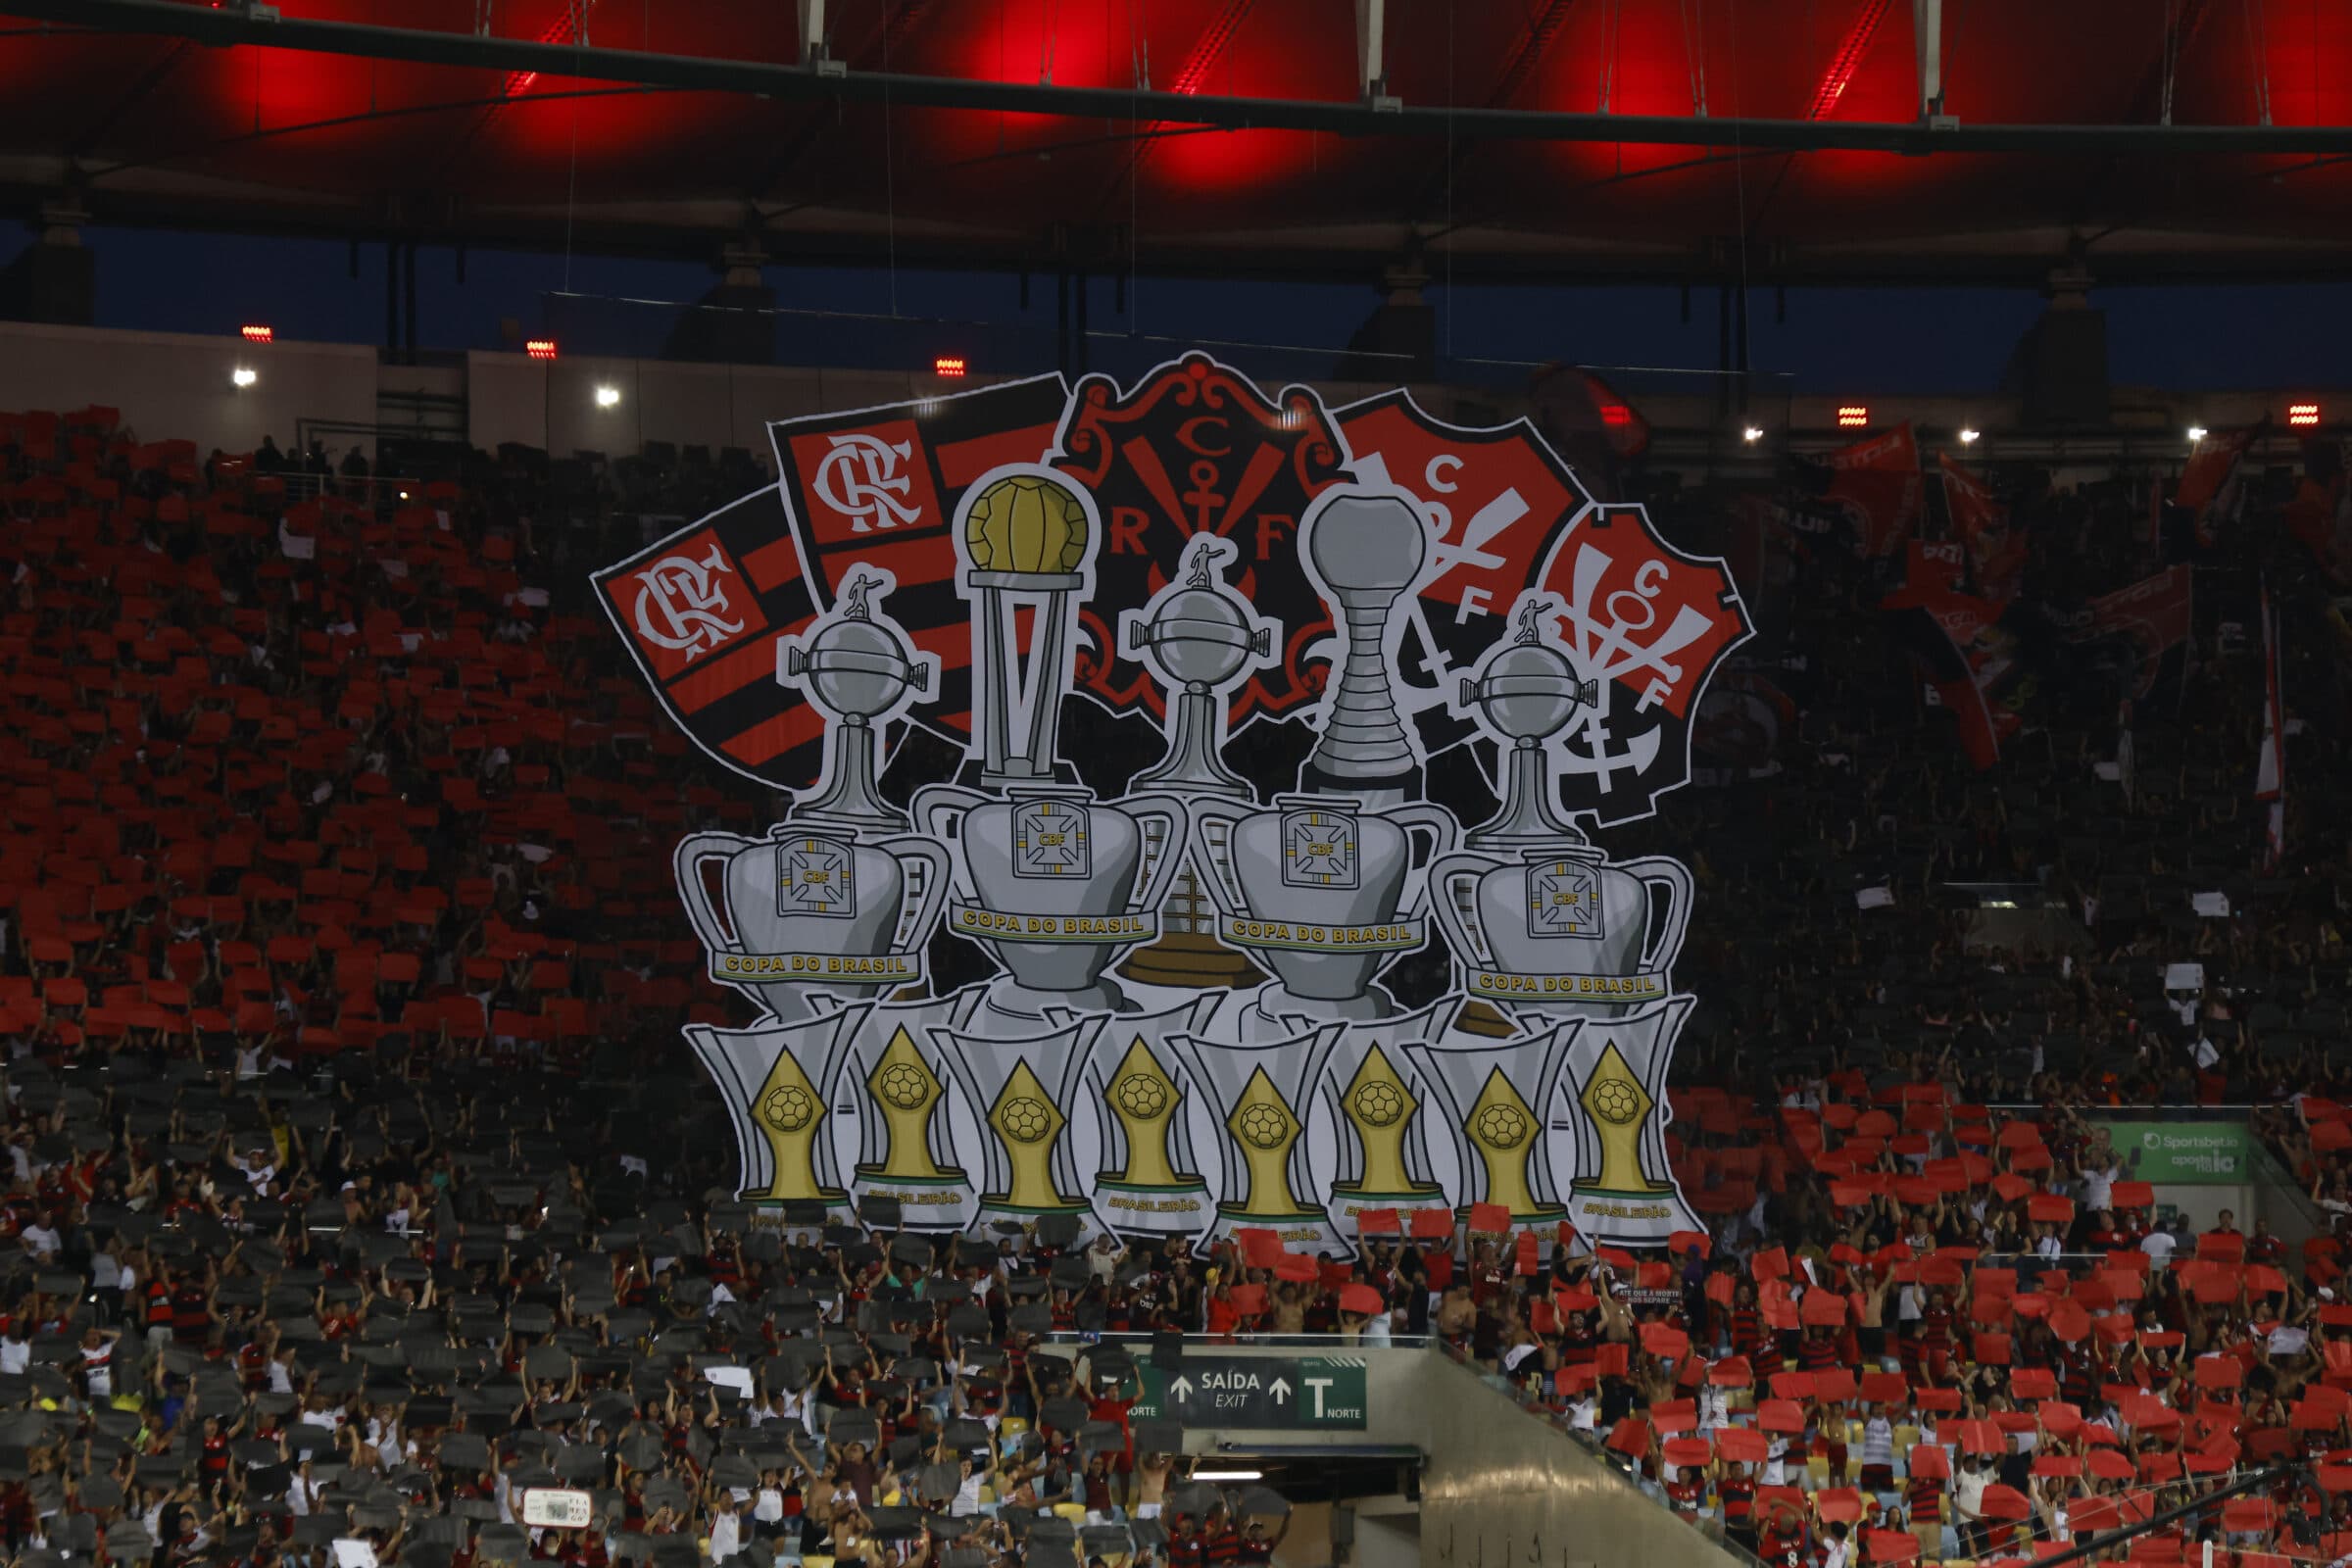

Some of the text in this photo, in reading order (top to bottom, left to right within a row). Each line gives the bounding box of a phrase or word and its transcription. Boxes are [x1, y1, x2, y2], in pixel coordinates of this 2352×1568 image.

[1425, 454, 1464, 493] C
[1109, 505, 1298, 561] R F
[1634, 559, 1670, 598] C
[1454, 585, 1494, 625] F
[1634, 676, 1673, 714] F
[1039, 833, 1066, 847] CBF
[1308, 843, 1334, 857] CBF
[803, 870, 830, 884] CBF
[1552, 893, 1579, 906] CBF
[963, 910, 1145, 934] COPA DO BRASIL
[1233, 920, 1411, 943] COPA DO BRASIL
[725, 956, 907, 973] COPA DO BRASIL
[1479, 973, 1655, 993] COPA DO BRASIL
[2163, 1136, 2238, 1150] Sportsbet.io
[1108, 1197, 1200, 1213] BRASILEIRÃO
[1583, 1202, 1672, 1219] BRASILEIRÃO
[1201, 1368, 1261, 1390] SAÍDA
[1215, 1394, 1249, 1408] EXIT
[1304, 1378, 1361, 1419] T NORTE
[1787, 1550, 1798, 1568] 8
